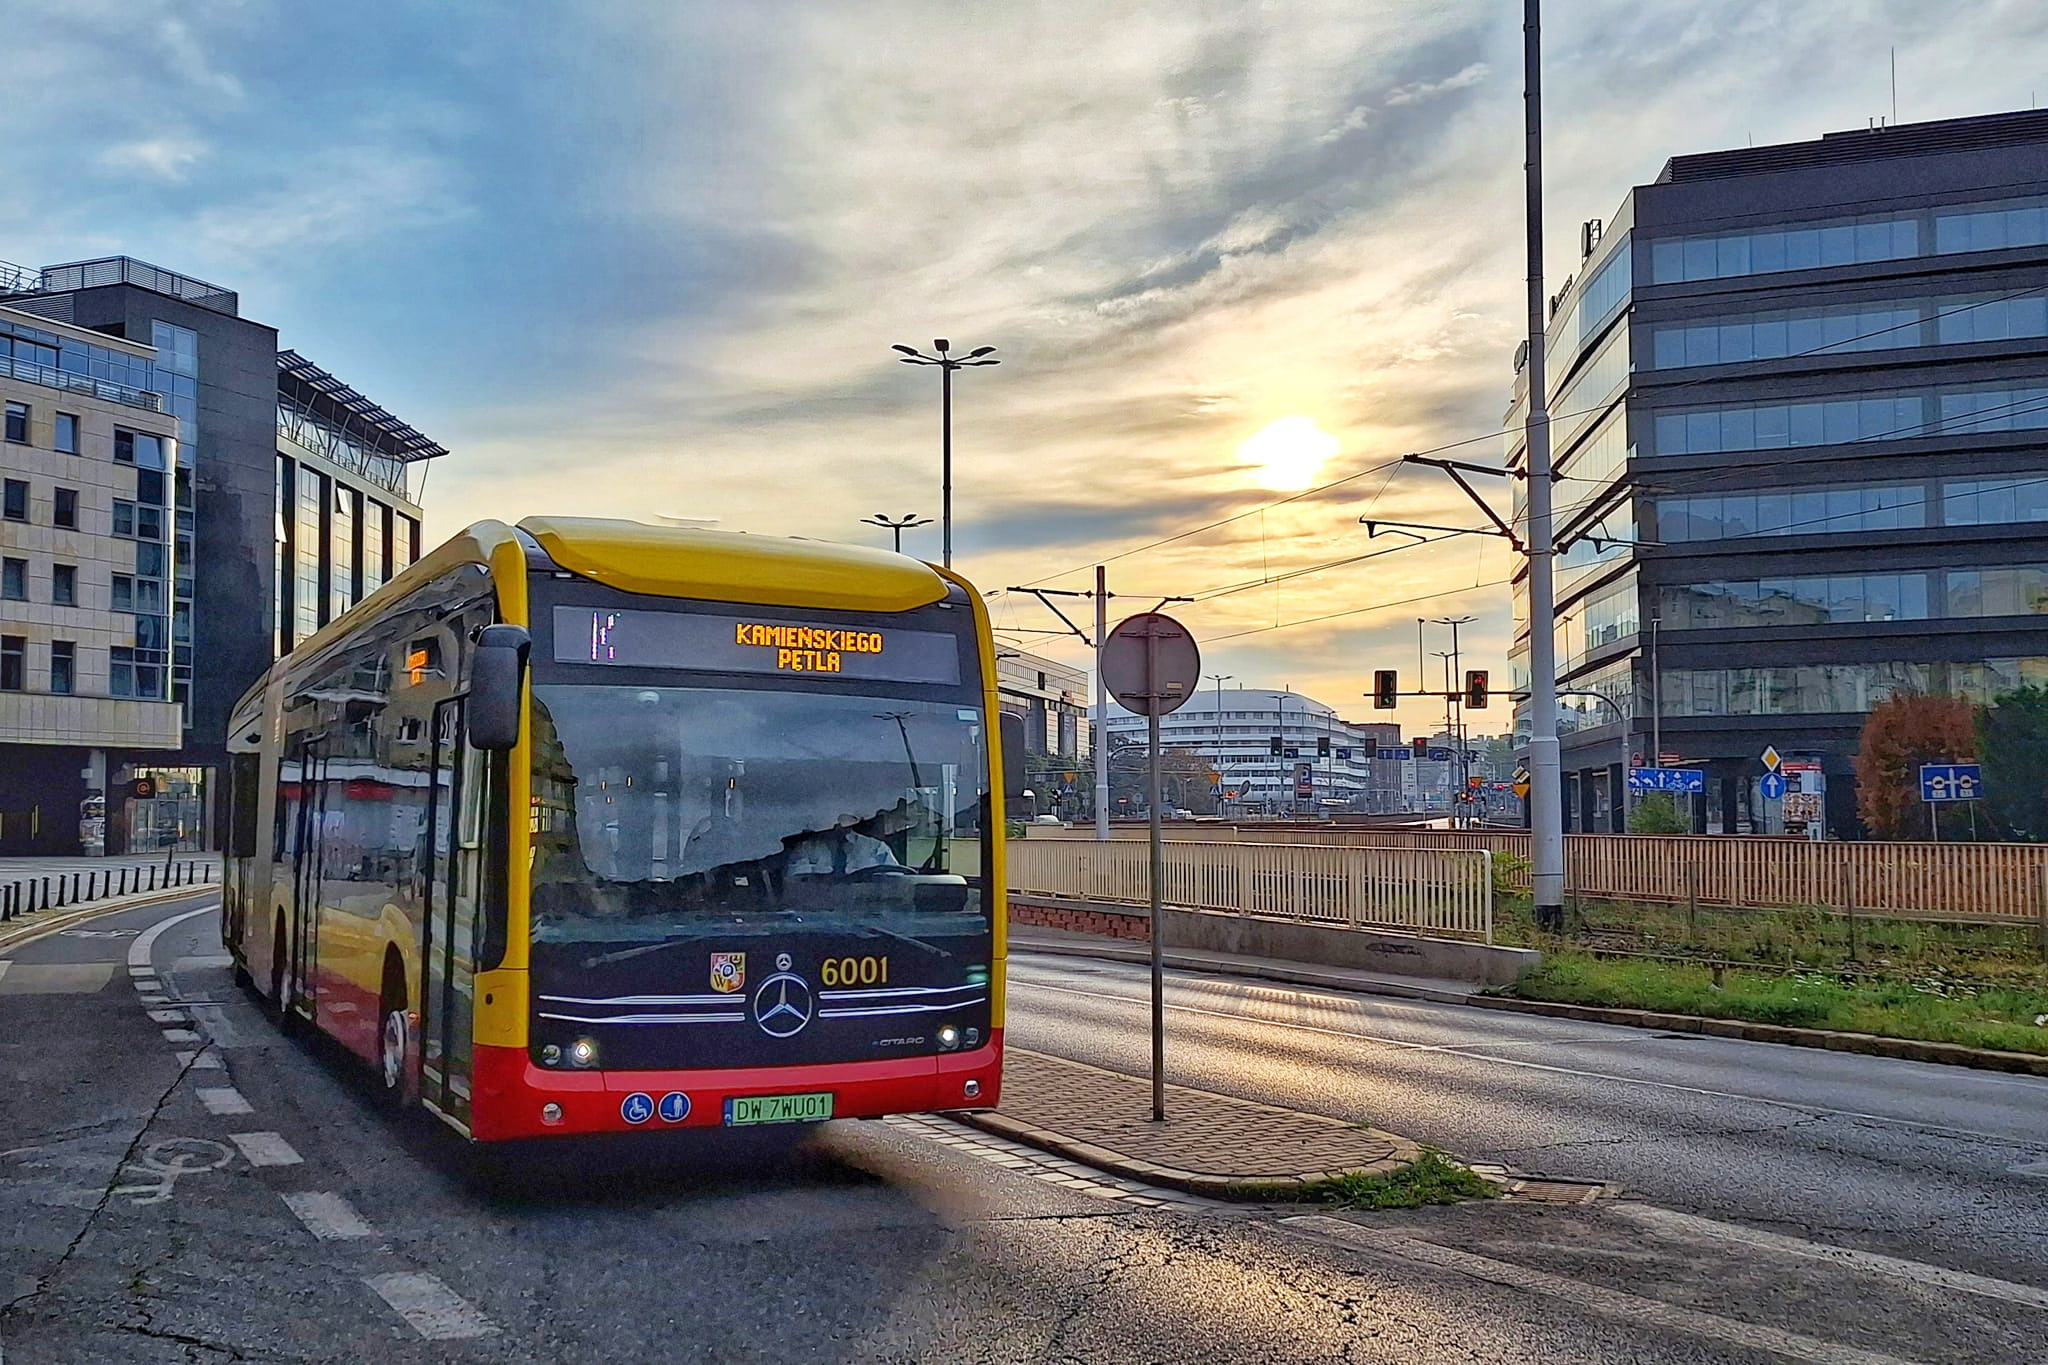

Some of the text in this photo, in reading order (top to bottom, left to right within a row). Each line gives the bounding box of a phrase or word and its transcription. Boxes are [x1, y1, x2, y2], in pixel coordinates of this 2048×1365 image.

[736, 623, 883, 653] KAMIEŃSKIEGO
[778, 648, 841, 672] PĘTLA
[821, 956, 888, 986] 6001
[737, 1096, 825, 1120] DW 7WU01
